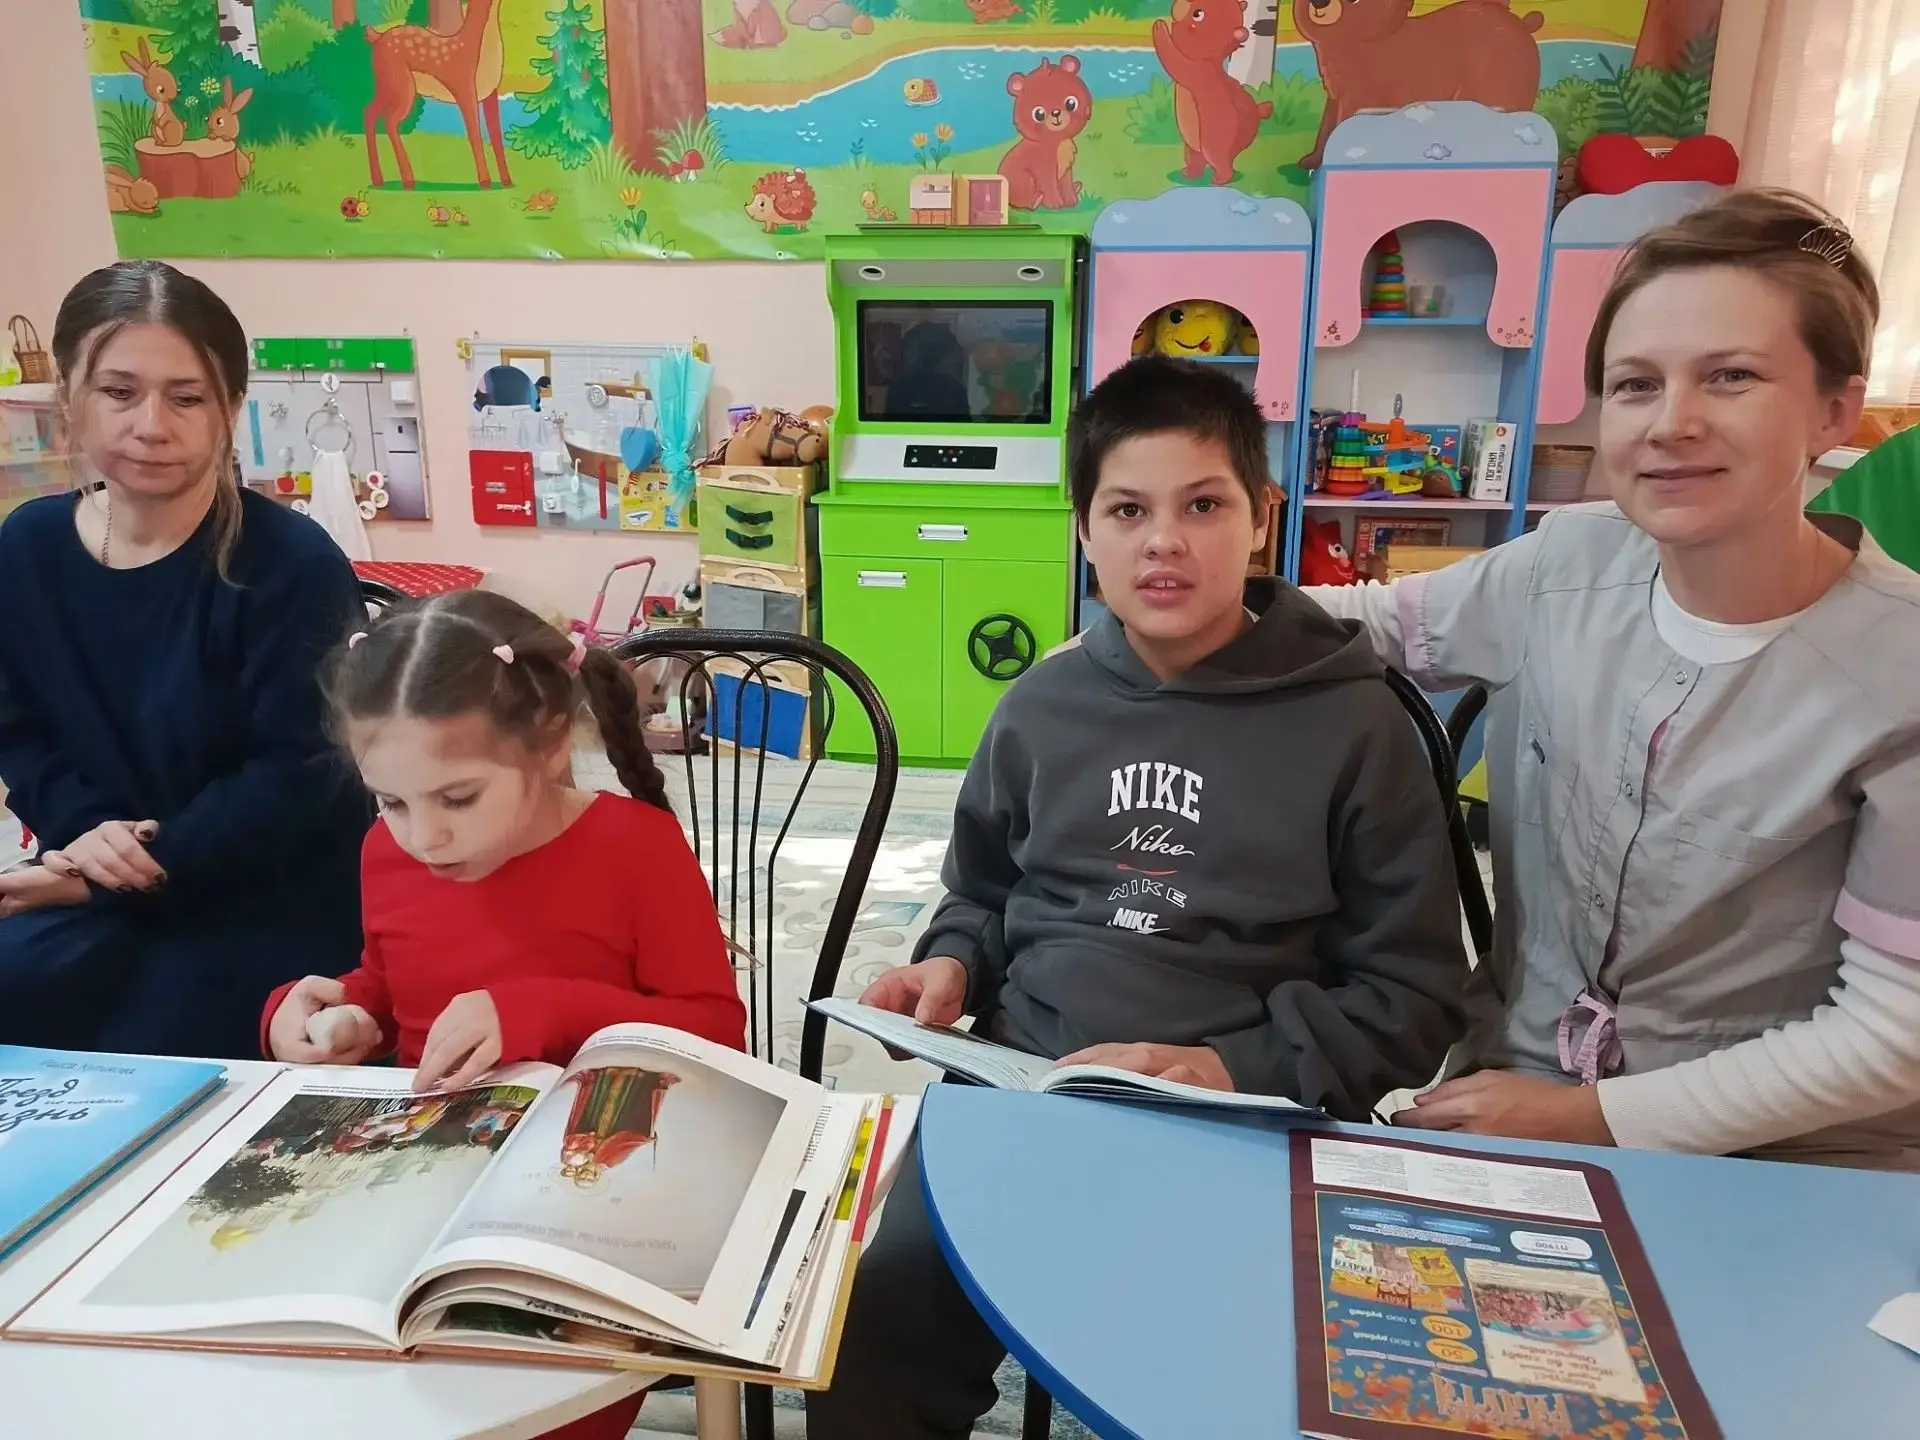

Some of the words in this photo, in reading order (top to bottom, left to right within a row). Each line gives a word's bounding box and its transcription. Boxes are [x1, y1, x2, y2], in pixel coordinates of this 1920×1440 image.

[1485, 452, 1497, 482] ПОГОНЯ
[1107, 762, 1203, 824] NIKE
[1110, 825, 1195, 856] Nike
[1108, 879, 1187, 908] NIKE
[1113, 907, 1159, 931] NIKE
[0, 1107, 90, 1133] изнь
[1431, 1324, 1463, 1337] 100
[1441, 1350, 1464, 1361] 50
